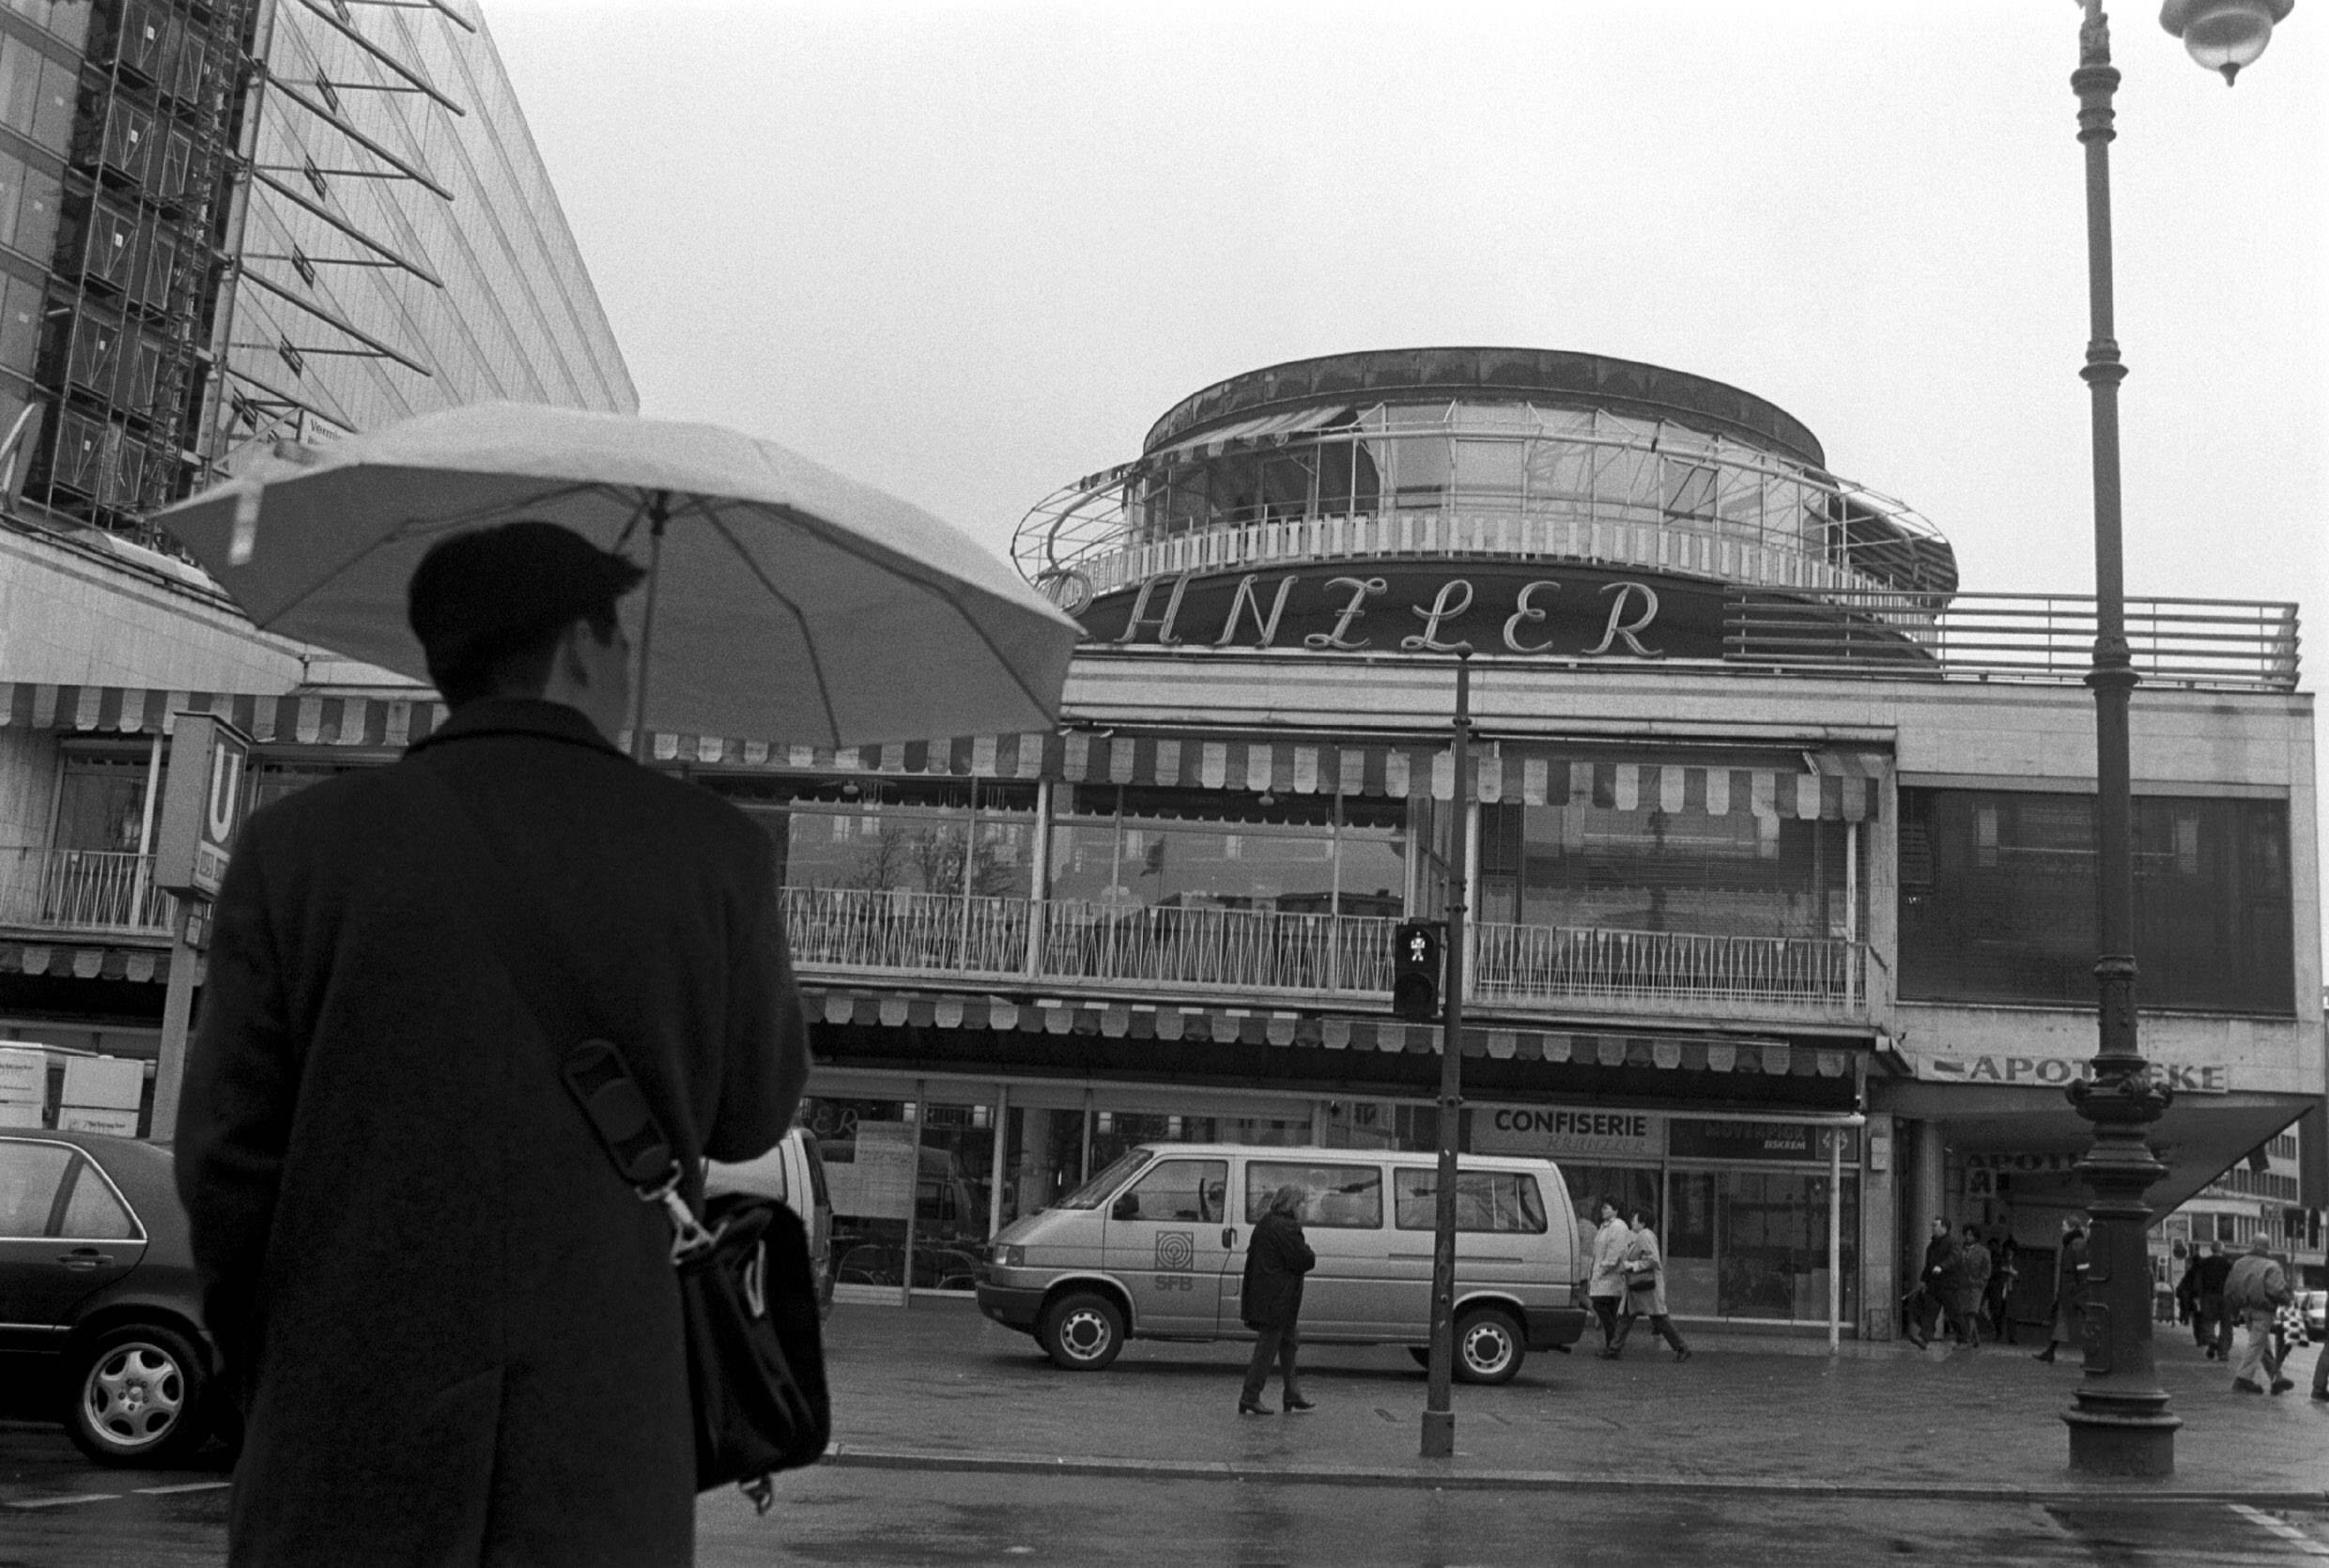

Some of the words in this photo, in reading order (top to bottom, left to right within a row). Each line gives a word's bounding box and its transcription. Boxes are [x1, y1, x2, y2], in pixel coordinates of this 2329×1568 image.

[1030, 569, 1665, 655] RANZLER
[208, 742, 239, 843] U
[1969, 1055, 2225, 1090] APOTEKE
[1494, 1109, 1646, 1136] CONFISERIE
[1764, 1139, 1806, 1150] EISKREM
[1154, 1275, 1194, 1291] SFB
